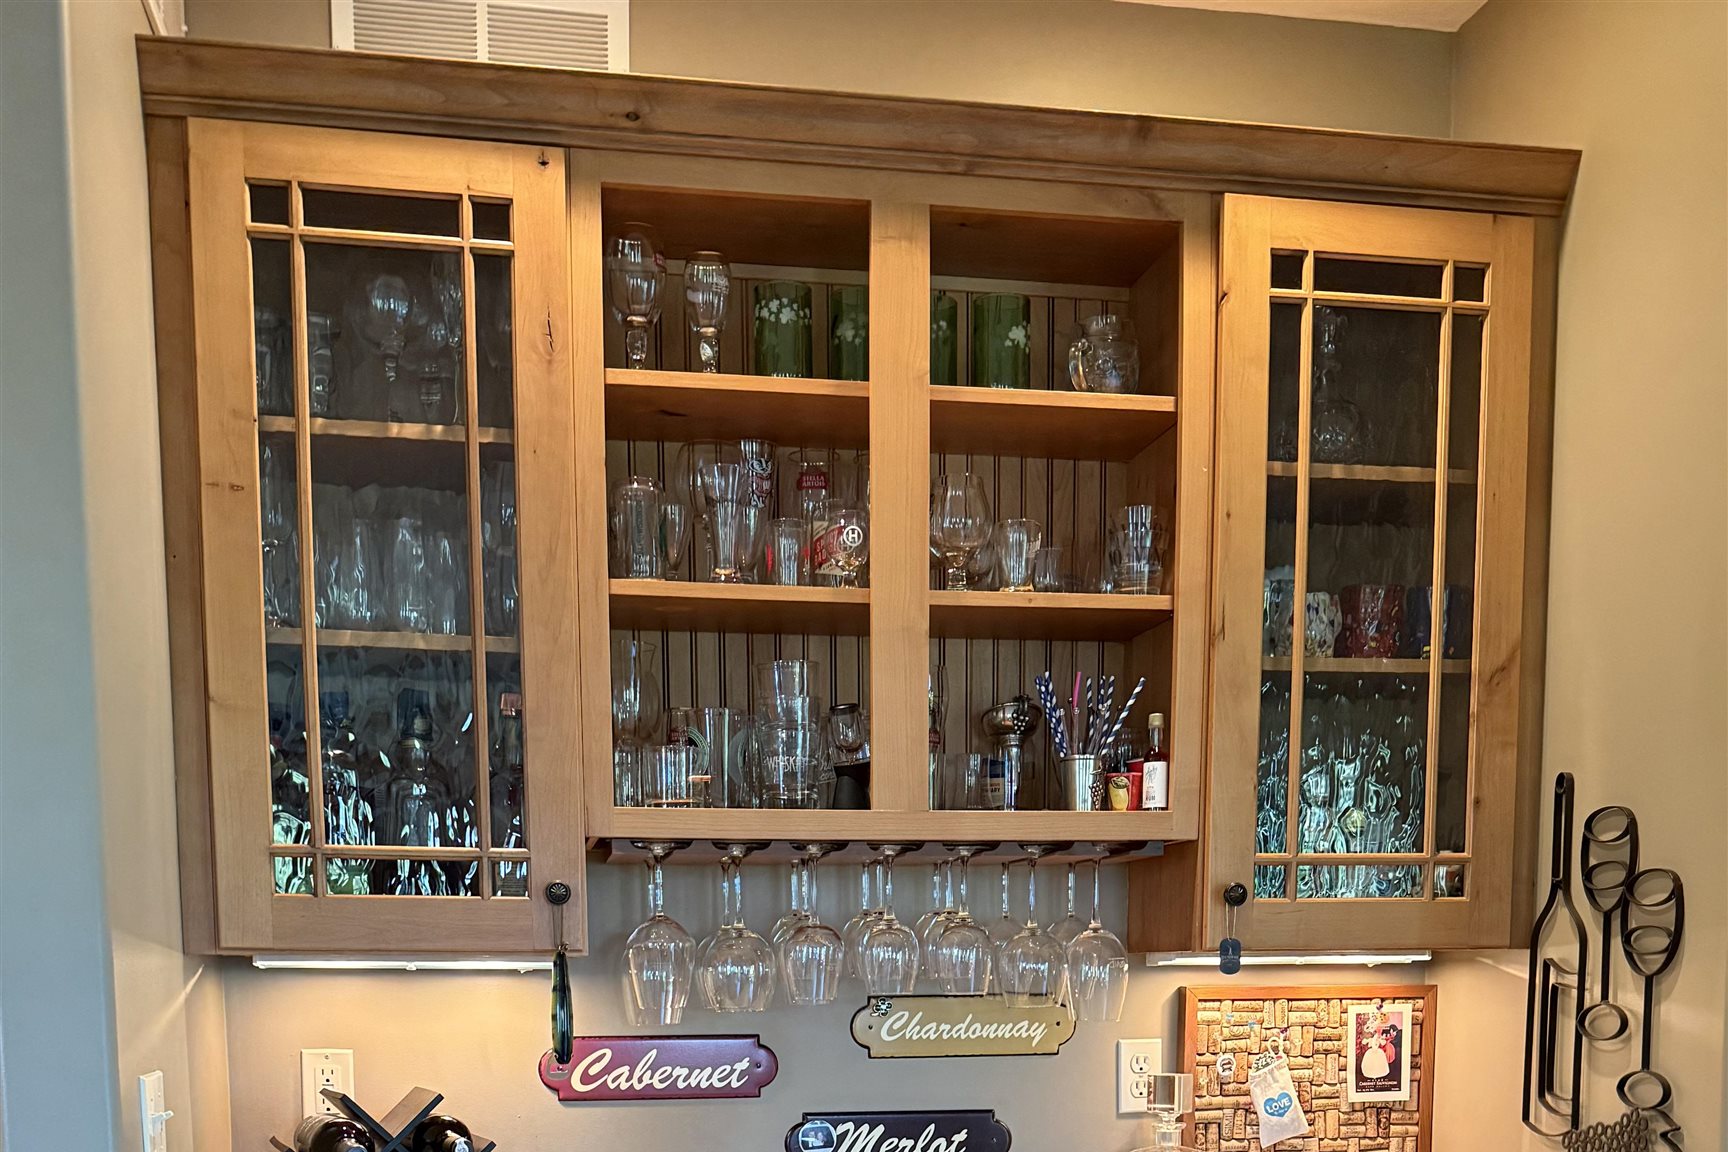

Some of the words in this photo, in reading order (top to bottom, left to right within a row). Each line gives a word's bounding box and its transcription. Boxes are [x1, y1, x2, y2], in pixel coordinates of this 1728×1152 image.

[880, 1009, 1050, 1048] Chardonnay
[570, 1048, 750, 1093] Cabernet
[1265, 1096, 1291, 1113] LOVE
[1224, 1115, 1233, 1135] SIMI
[1235, 1113, 1243, 1135] SIMI
